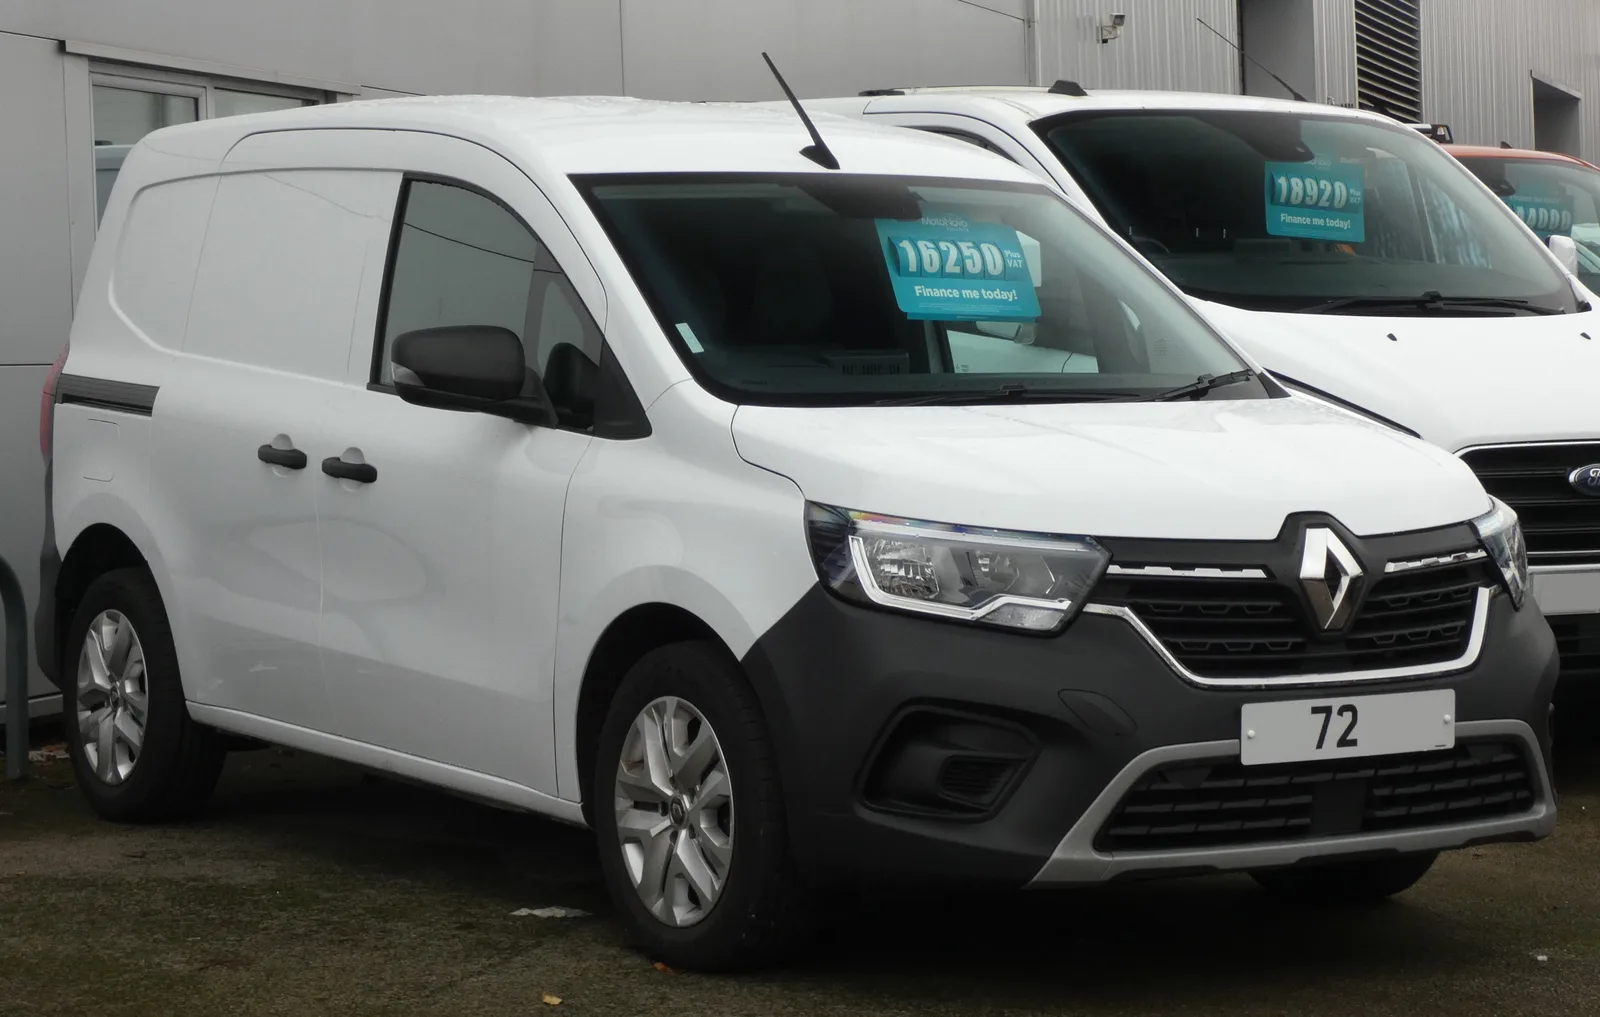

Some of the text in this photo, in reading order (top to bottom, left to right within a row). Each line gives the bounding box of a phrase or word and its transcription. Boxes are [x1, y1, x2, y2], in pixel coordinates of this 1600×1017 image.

[1278, 176, 1347, 208] 18920
[1281, 213, 1351, 230] Finance me today!
[899, 240, 1004, 275] 16250
[1004, 250, 1021, 258] Plus
[1007, 259, 1024, 268] VAT
[914, 285, 1018, 302] Finance me today!
[1311, 704, 1358, 750] 72
